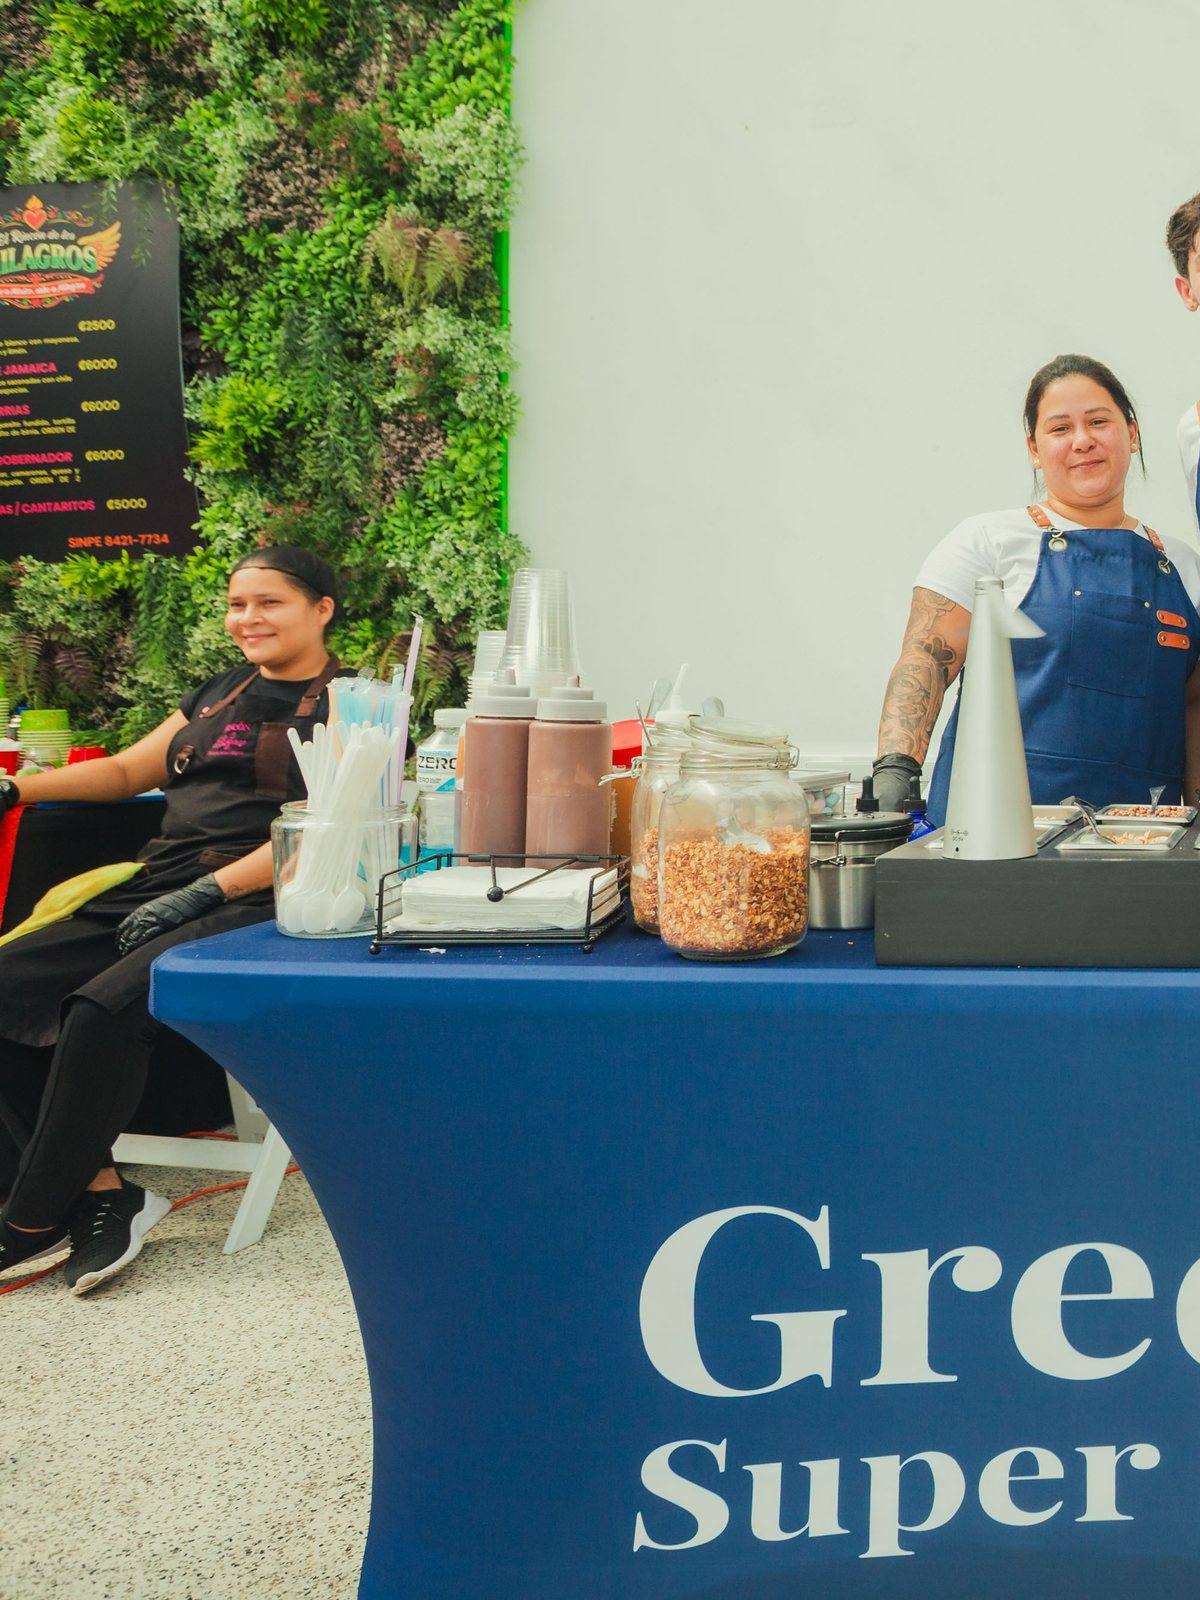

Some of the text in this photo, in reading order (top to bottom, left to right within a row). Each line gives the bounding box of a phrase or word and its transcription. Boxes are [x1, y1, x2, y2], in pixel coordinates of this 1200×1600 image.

[0, 243, 97, 275] ILAGROS
[4, 362, 57, 375] JAMAICA
[21, 499, 96, 514] CANTARITOS
[68, 536, 102, 548] SINPE
[633, 1439, 1160, 1558] Super
